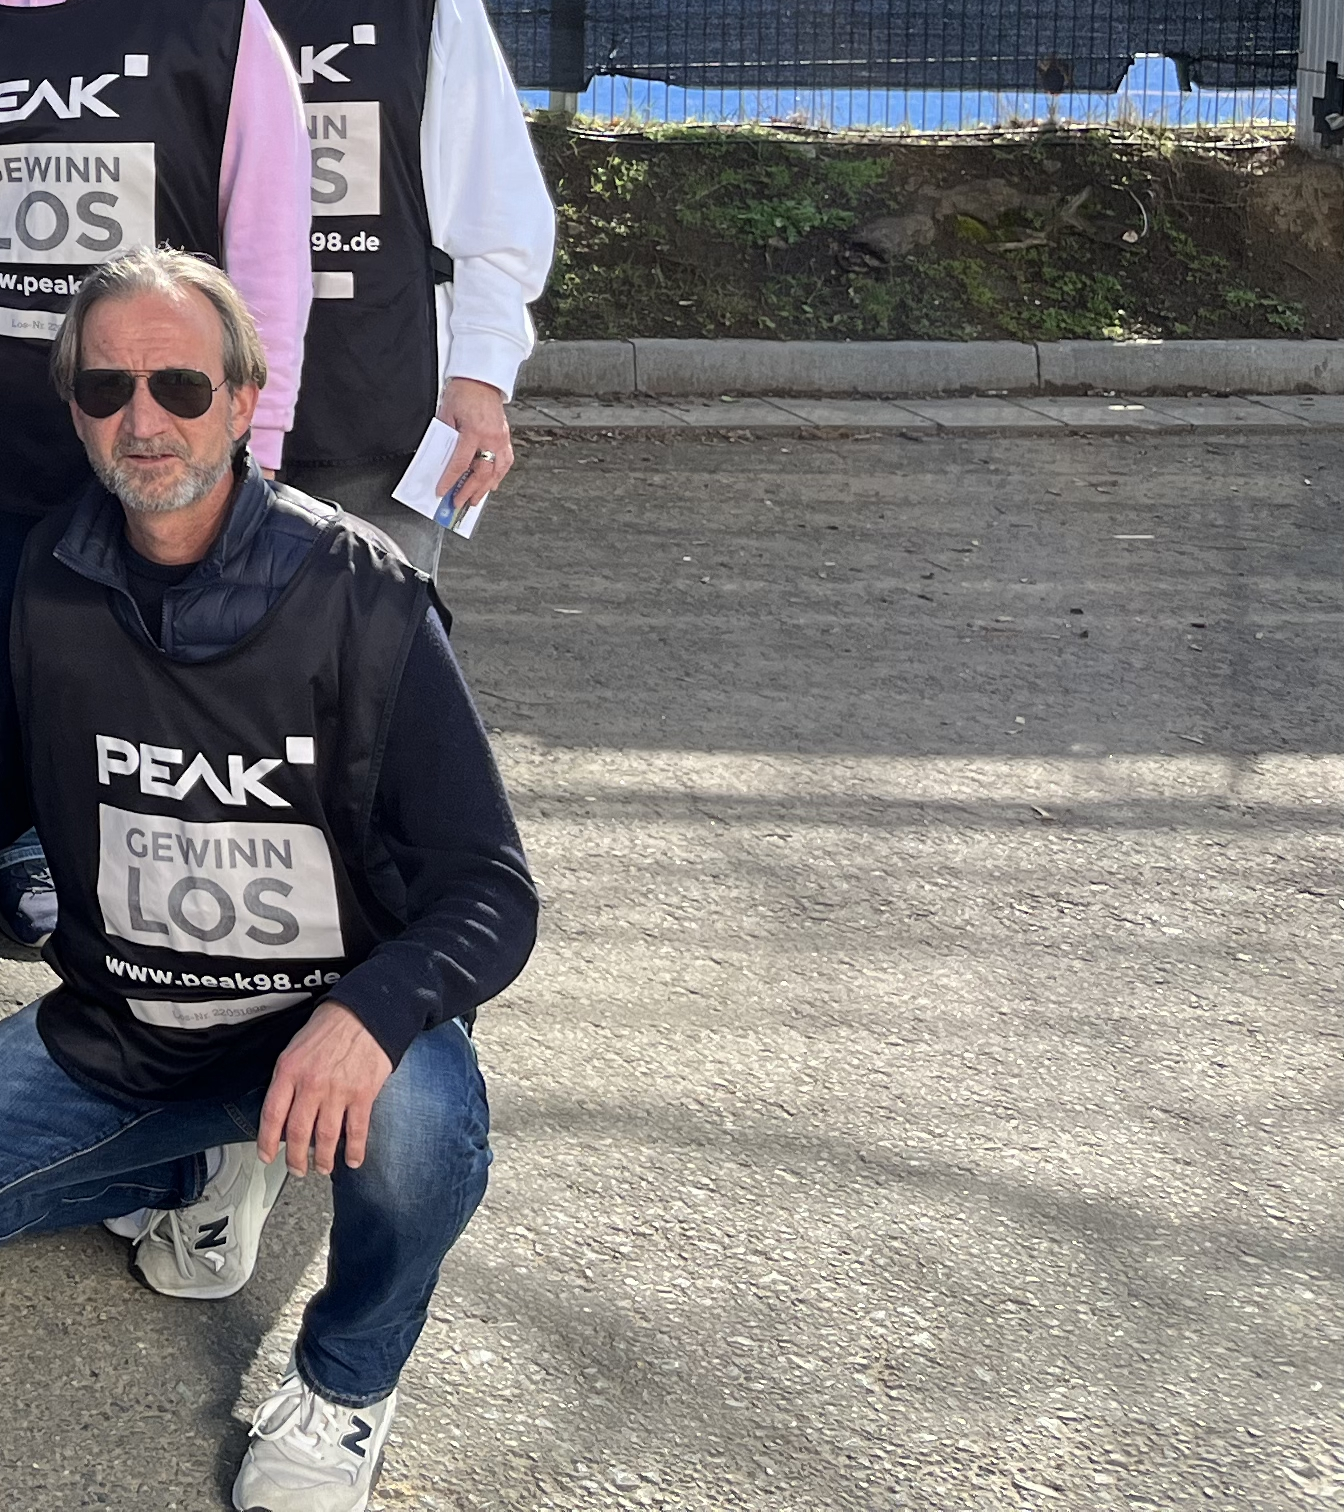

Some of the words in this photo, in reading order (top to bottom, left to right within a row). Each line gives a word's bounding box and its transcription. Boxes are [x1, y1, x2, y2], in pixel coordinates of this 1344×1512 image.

[95, 734, 294, 809] PEAK
[125, 827, 294, 871] GEWINN
[127, 864, 301, 947] LOS
